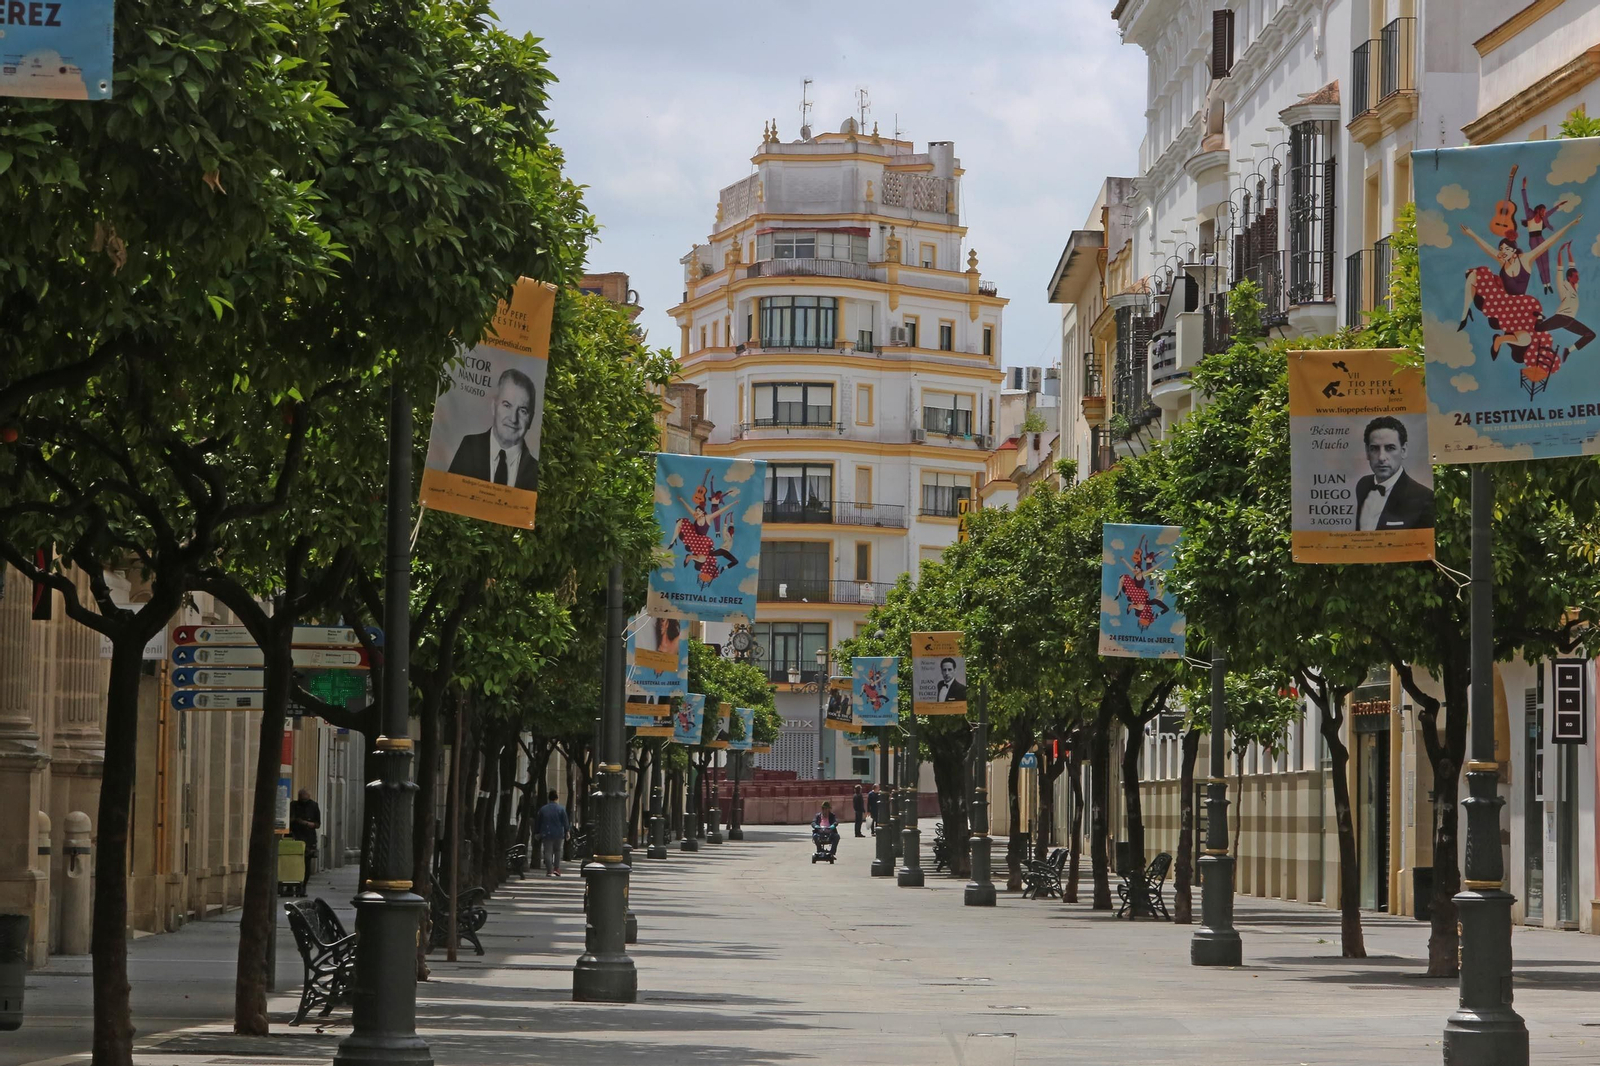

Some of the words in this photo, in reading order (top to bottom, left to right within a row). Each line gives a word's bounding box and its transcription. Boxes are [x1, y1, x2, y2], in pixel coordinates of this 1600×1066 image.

[510, 310, 528, 321] PEPE
[458, 368, 493, 388] MANUEL
[1316, 406, 1407, 414] www.tiopepefestival.com
[1454, 412, 1472, 426] 24
[1476, 408, 1545, 424] FESTIVAL
[1548, 408, 1564, 419] DE
[1310, 424, 1350, 436] Bésame
[1311, 438, 1350, 450] Mucho
[1314, 474, 1346, 486] JUAN
[1310, 489, 1351, 500] DIEGO
[1308, 502, 1354, 516] FLÓREZ
[1318, 517, 1352, 526] AGOSTO
[660, 592, 669, 600] 24
[670, 593, 707, 602] FESTIVAL
[718, 596, 743, 605] JEREZ
[1118, 635, 1146, 644] FESTIVAL
